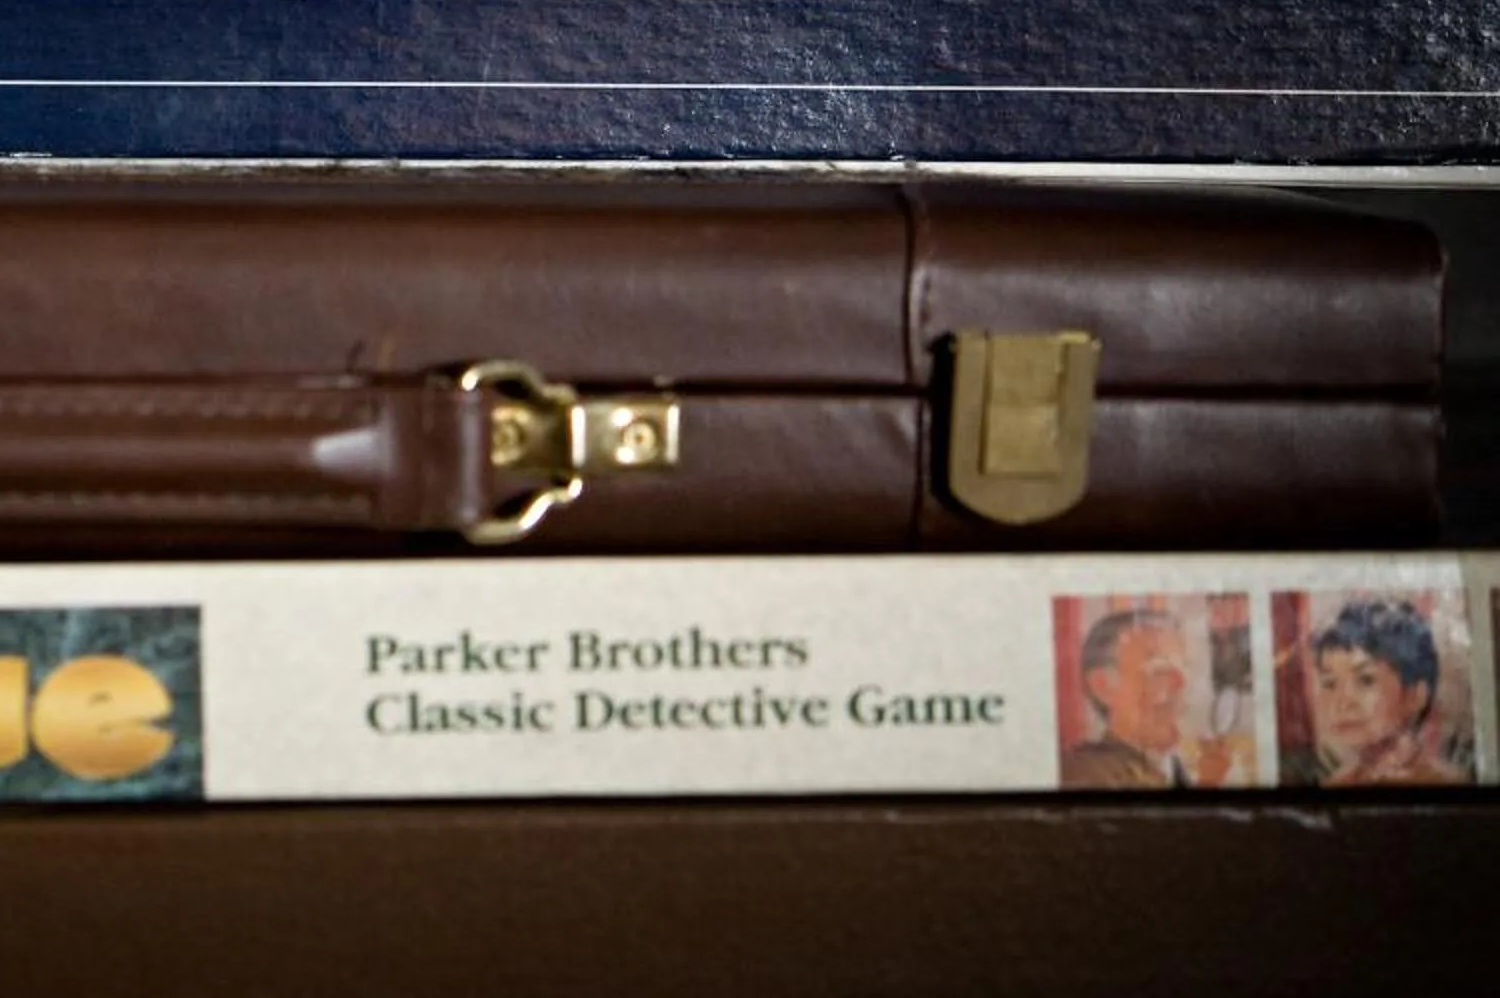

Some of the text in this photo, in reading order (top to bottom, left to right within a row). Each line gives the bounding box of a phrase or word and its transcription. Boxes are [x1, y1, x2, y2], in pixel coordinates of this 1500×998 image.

[365, 628, 809, 674] Parker Brothers
[366, 684, 1006, 735] Classic Detective Game
